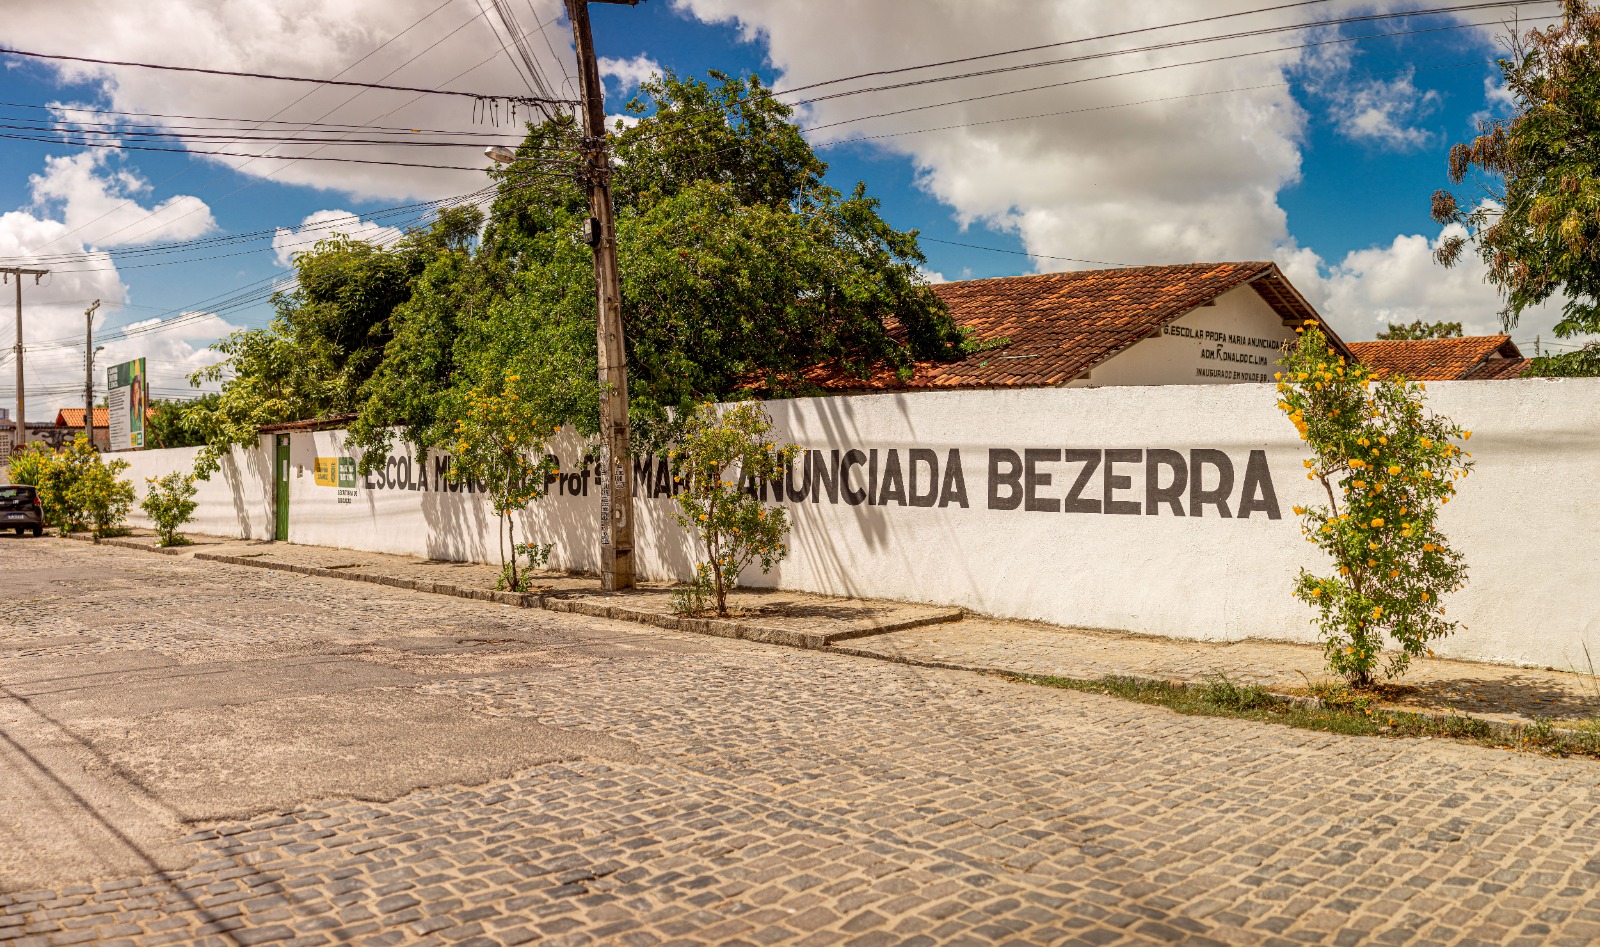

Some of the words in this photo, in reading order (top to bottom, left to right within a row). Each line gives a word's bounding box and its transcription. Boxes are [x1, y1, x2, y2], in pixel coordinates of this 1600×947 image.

[1228, 334, 1246, 346] MARIA
[1247, 337, 1280, 350] ANUNCIADA
[365, 455, 428, 492] ESCOLA
[988, 448, 1282, 520] BEZERRA
